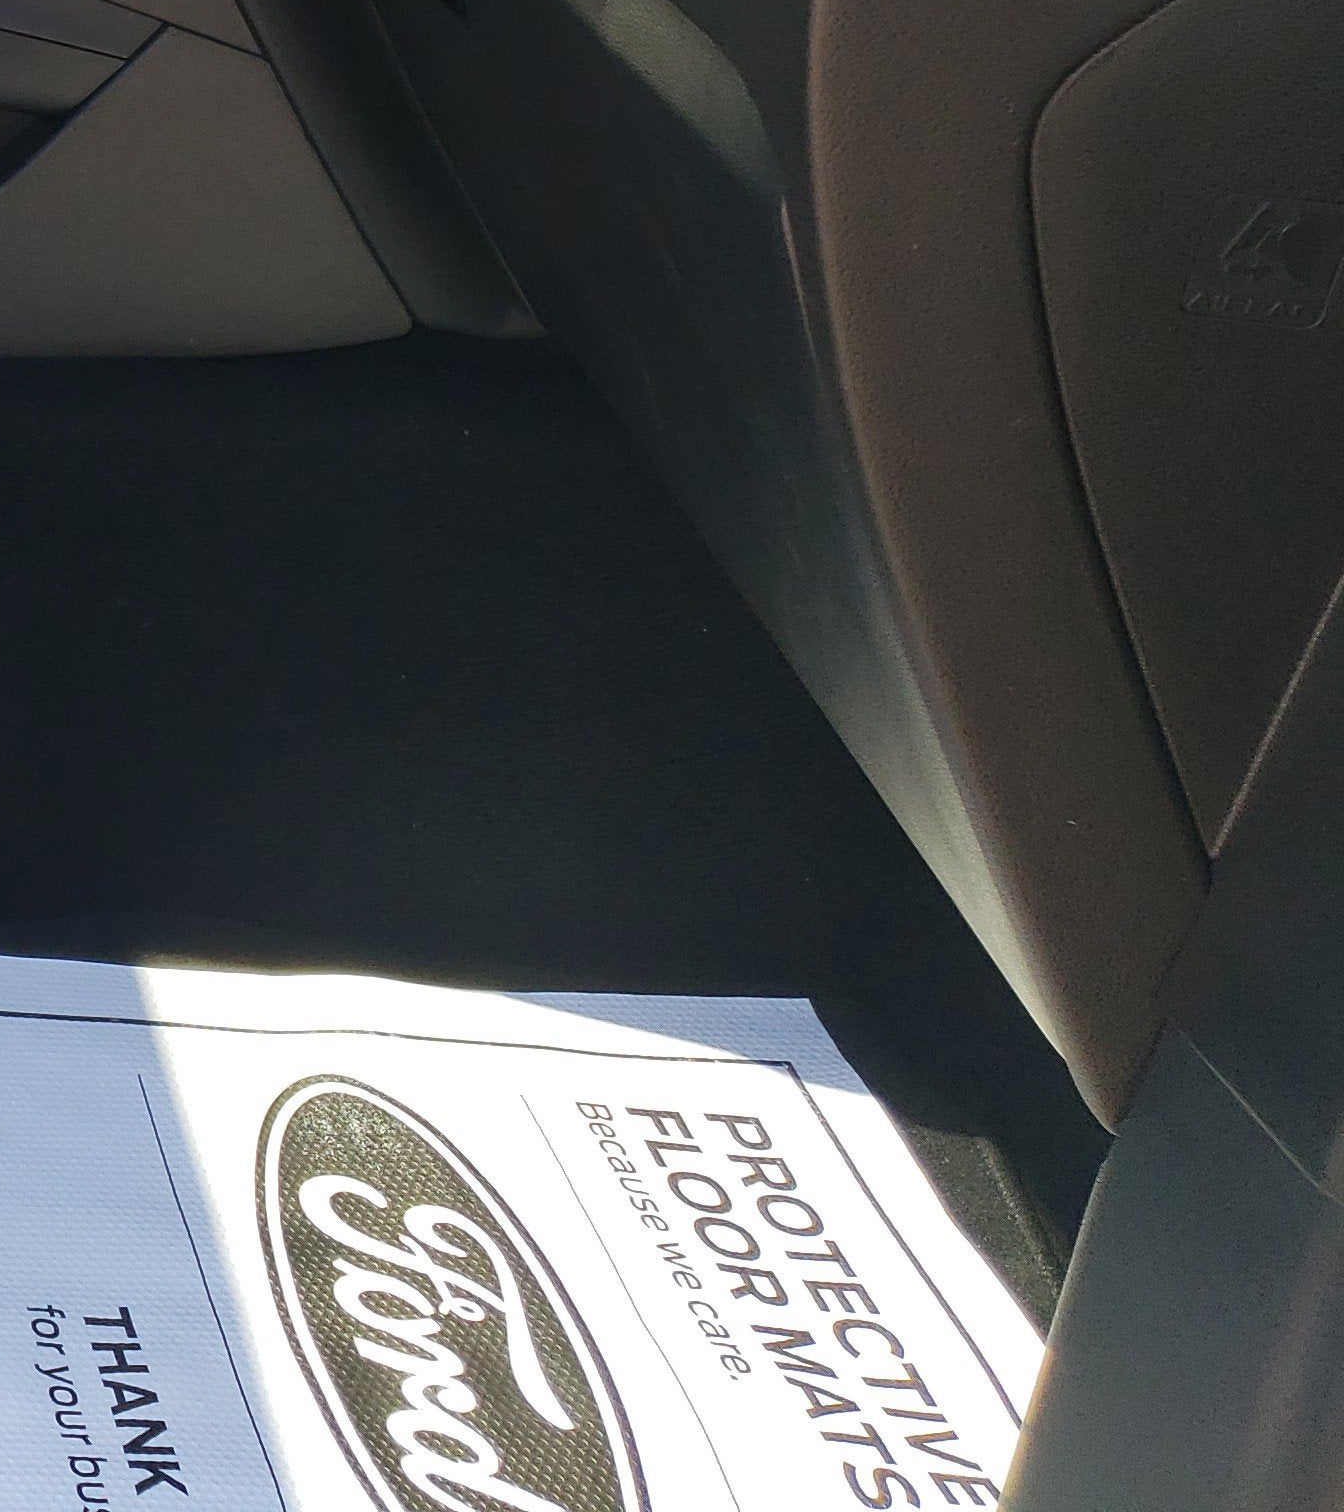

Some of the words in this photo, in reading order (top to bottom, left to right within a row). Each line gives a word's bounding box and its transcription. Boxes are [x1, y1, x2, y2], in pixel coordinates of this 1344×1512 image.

[26, 1304, 67, 1356] for
[298, 1173, 580, 1512] Ford
[575, 1101, 670, 1232] Because
[656, 1242, 703, 1291] we
[688, 1300, 752, 1381] care.
[625, 1106, 789, 1307] FLOOR
[750, 1324, 921, 1510] MATS
[703, 1112, 1002, 1506] PROTECTIVE
[34, 1363, 93, 1446] your
[83, 1306, 190, 1497] THANK
